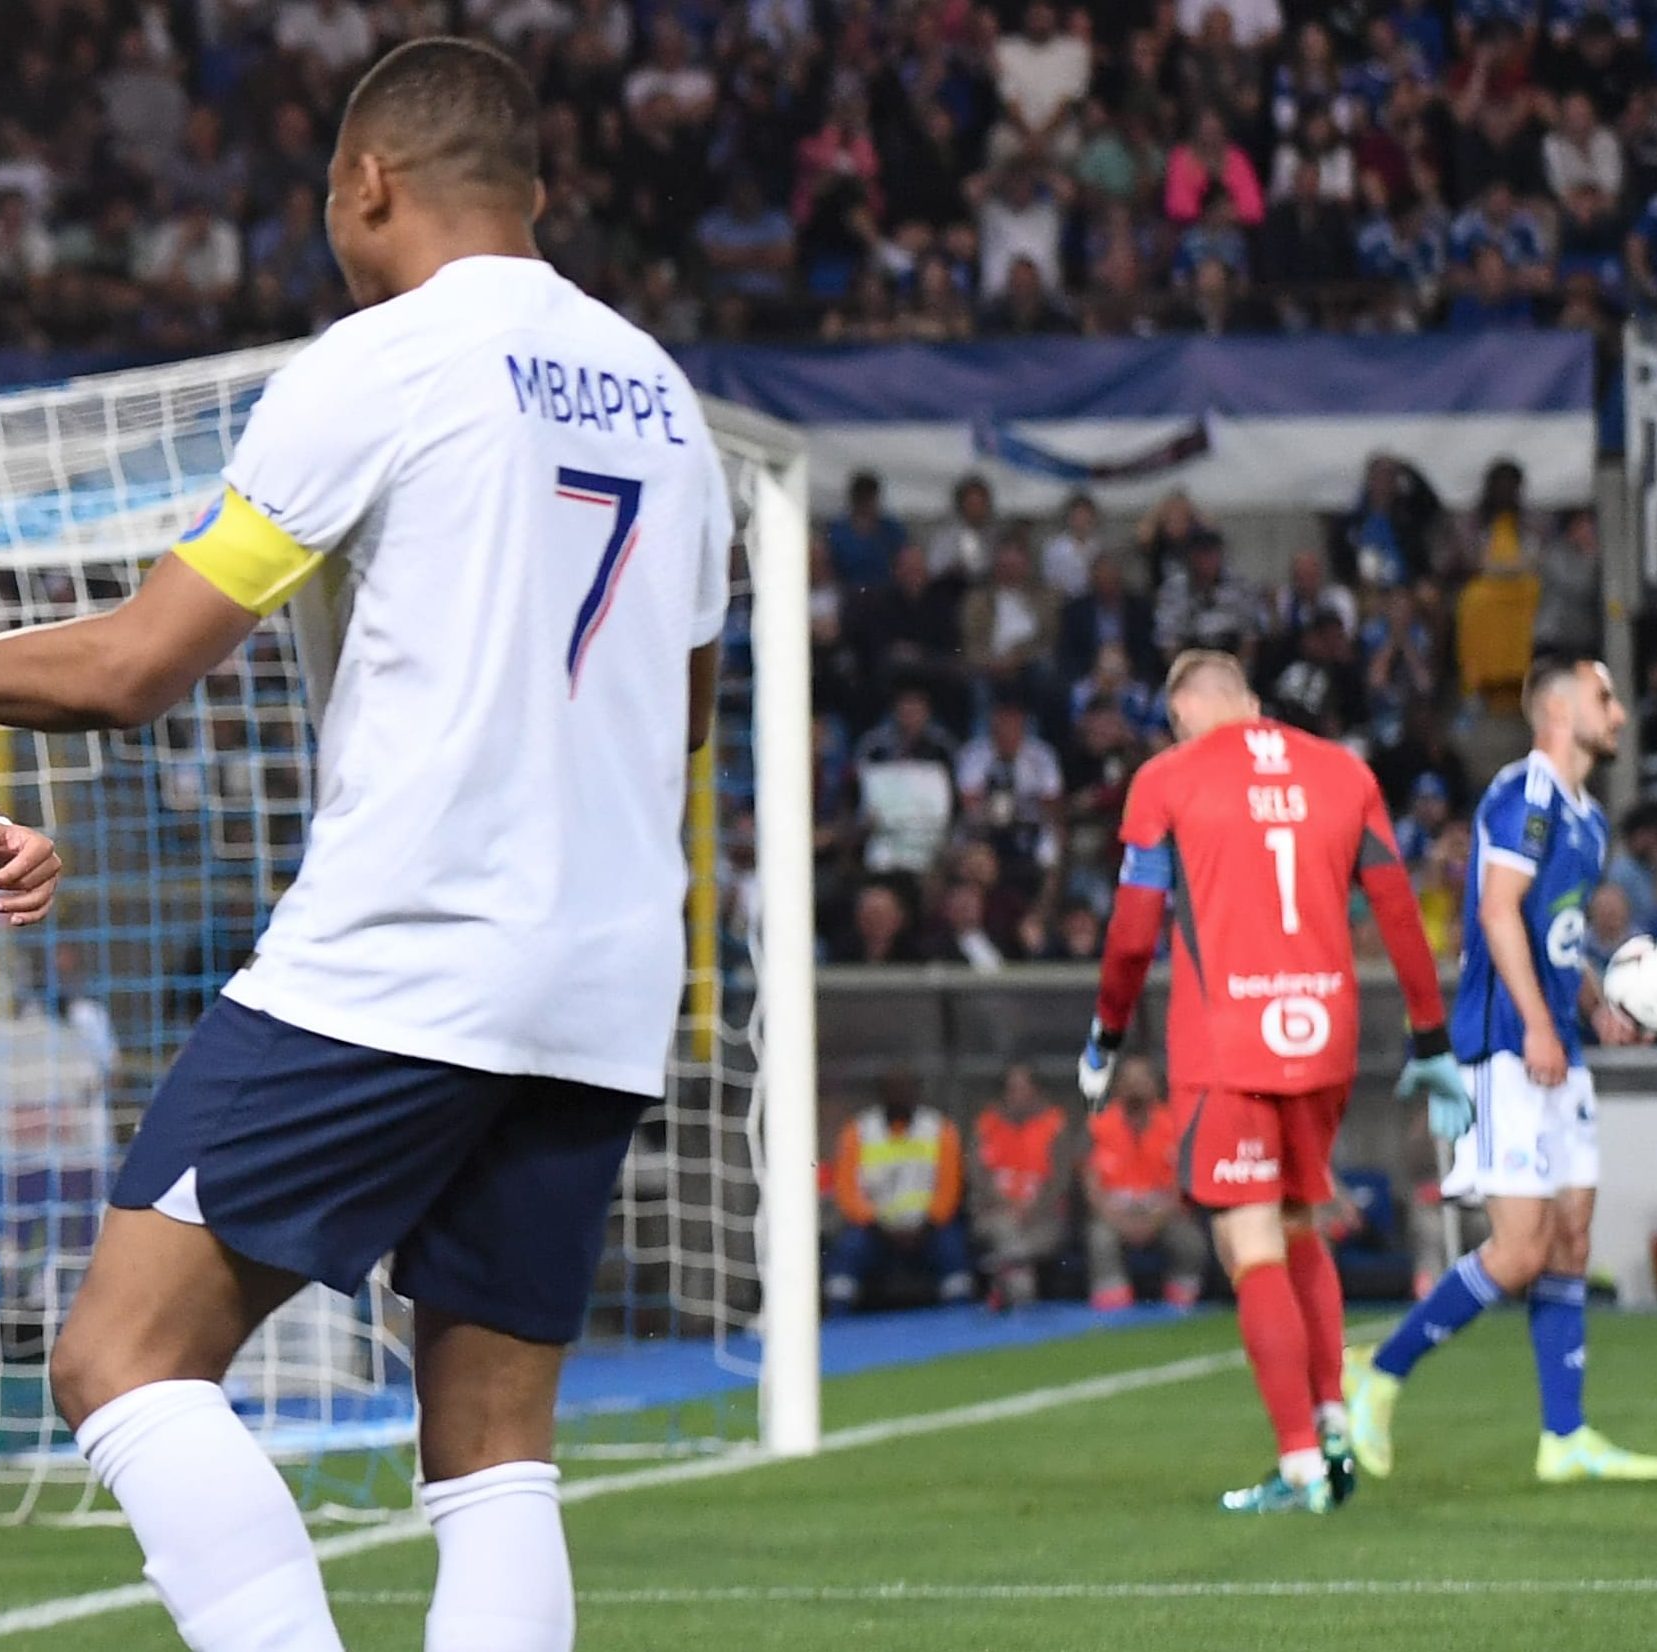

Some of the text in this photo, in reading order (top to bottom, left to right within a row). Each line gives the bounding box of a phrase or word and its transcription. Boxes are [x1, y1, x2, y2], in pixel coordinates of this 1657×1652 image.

[505, 353, 686, 446] MBAPPÉ
[556, 464, 643, 702] 7
[1247, 785, 1308, 823] SELS
[1264, 827, 1300, 935] 1
